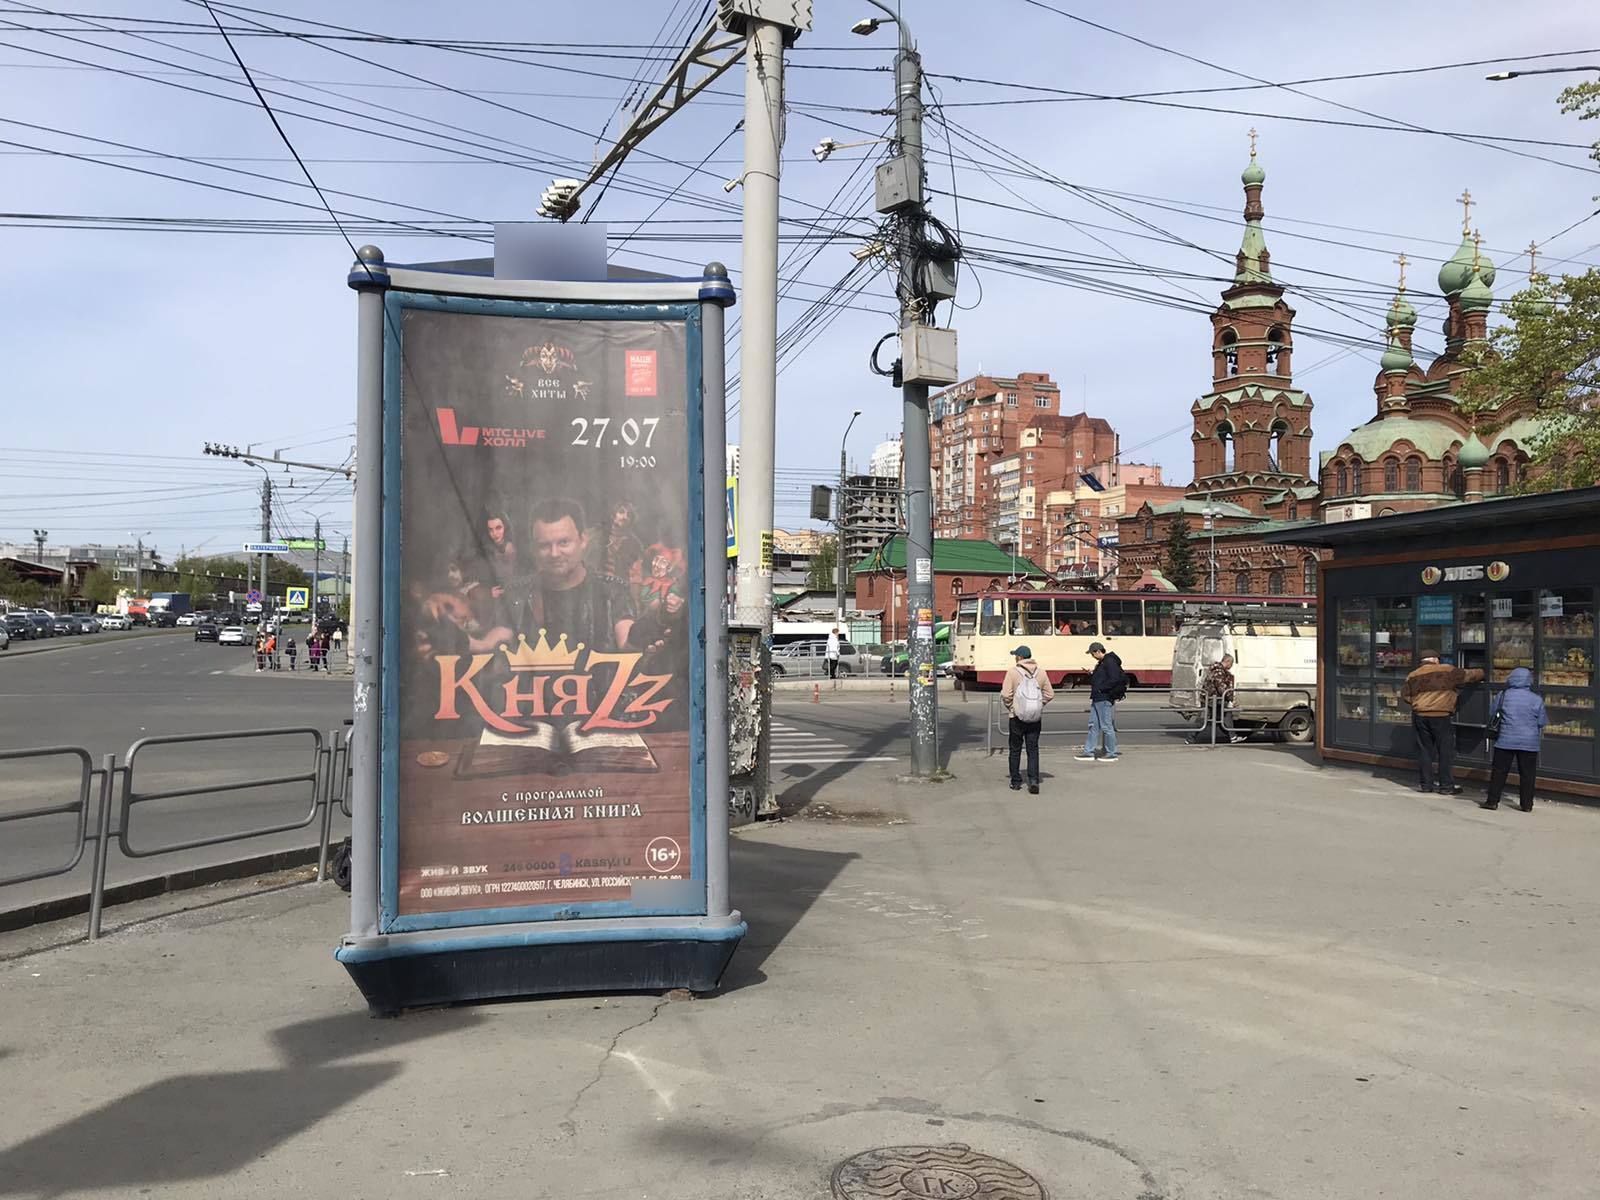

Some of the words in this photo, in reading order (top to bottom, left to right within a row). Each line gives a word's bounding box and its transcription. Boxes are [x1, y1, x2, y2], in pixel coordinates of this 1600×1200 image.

[531, 389, 567, 399] ХИТЫ
[512, 428, 546, 439] LIVE
[571, 416, 660, 448] 27.07
[482, 437, 526, 447] ХОЛЛ
[619, 455, 656, 468] 19:00
[1444, 565, 1485, 581] ХЛЕБ
[501, 792, 509, 801] с
[515, 787, 603, 803] программой
[461, 806, 574, 824] ВОЛШЕБНАЯ
[583, 803, 642, 818] КНИГА
[650, 847, 678, 861] 16+
[462, 864, 489, 874] ЗВУК
[484, 882, 500, 893] ОГРН
